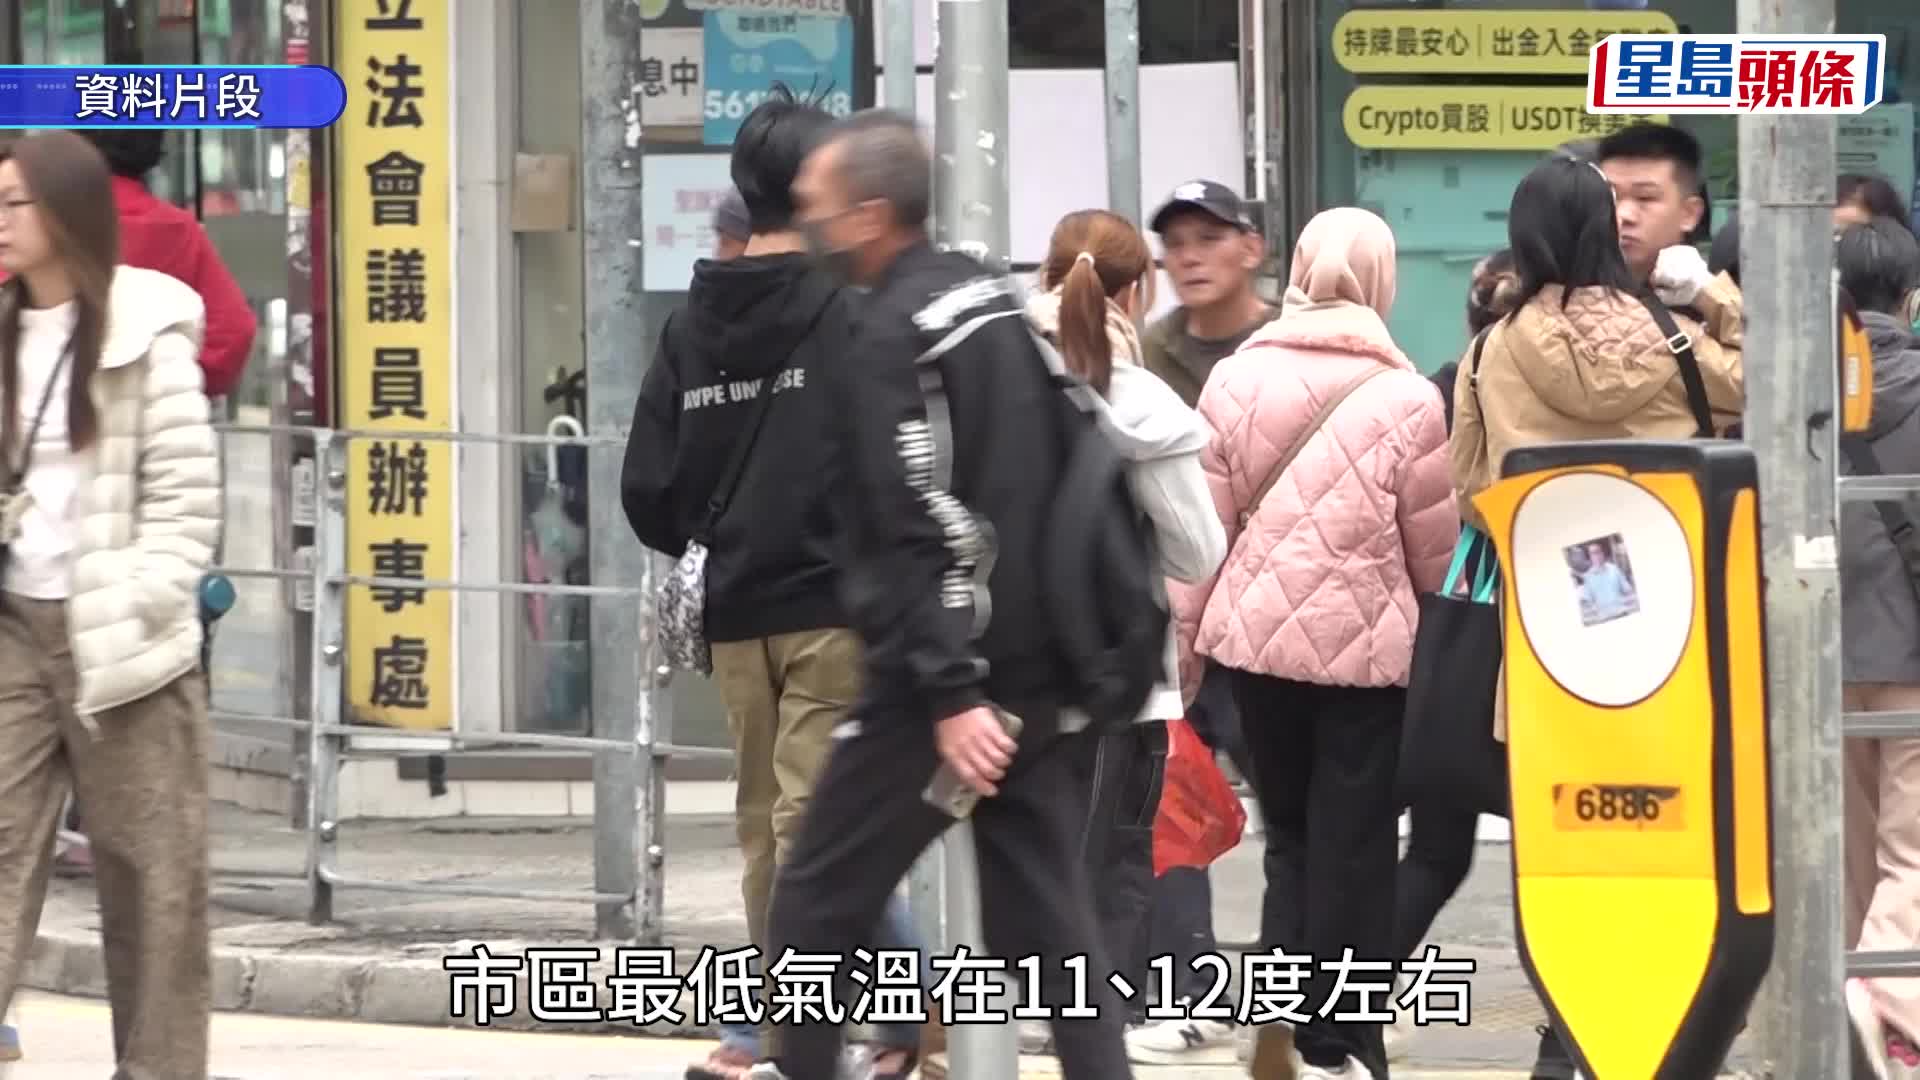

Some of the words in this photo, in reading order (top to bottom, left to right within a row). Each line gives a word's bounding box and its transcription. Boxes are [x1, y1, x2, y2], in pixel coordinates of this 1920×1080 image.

[1345, 26, 1470, 57] 持牌最安心
[1492, 27, 1668, 56] 出金入金
[704, 90, 851, 119] 5618
[1358, 103, 1489, 136] Crypto買股
[1576, 787, 1660, 822] 6886
